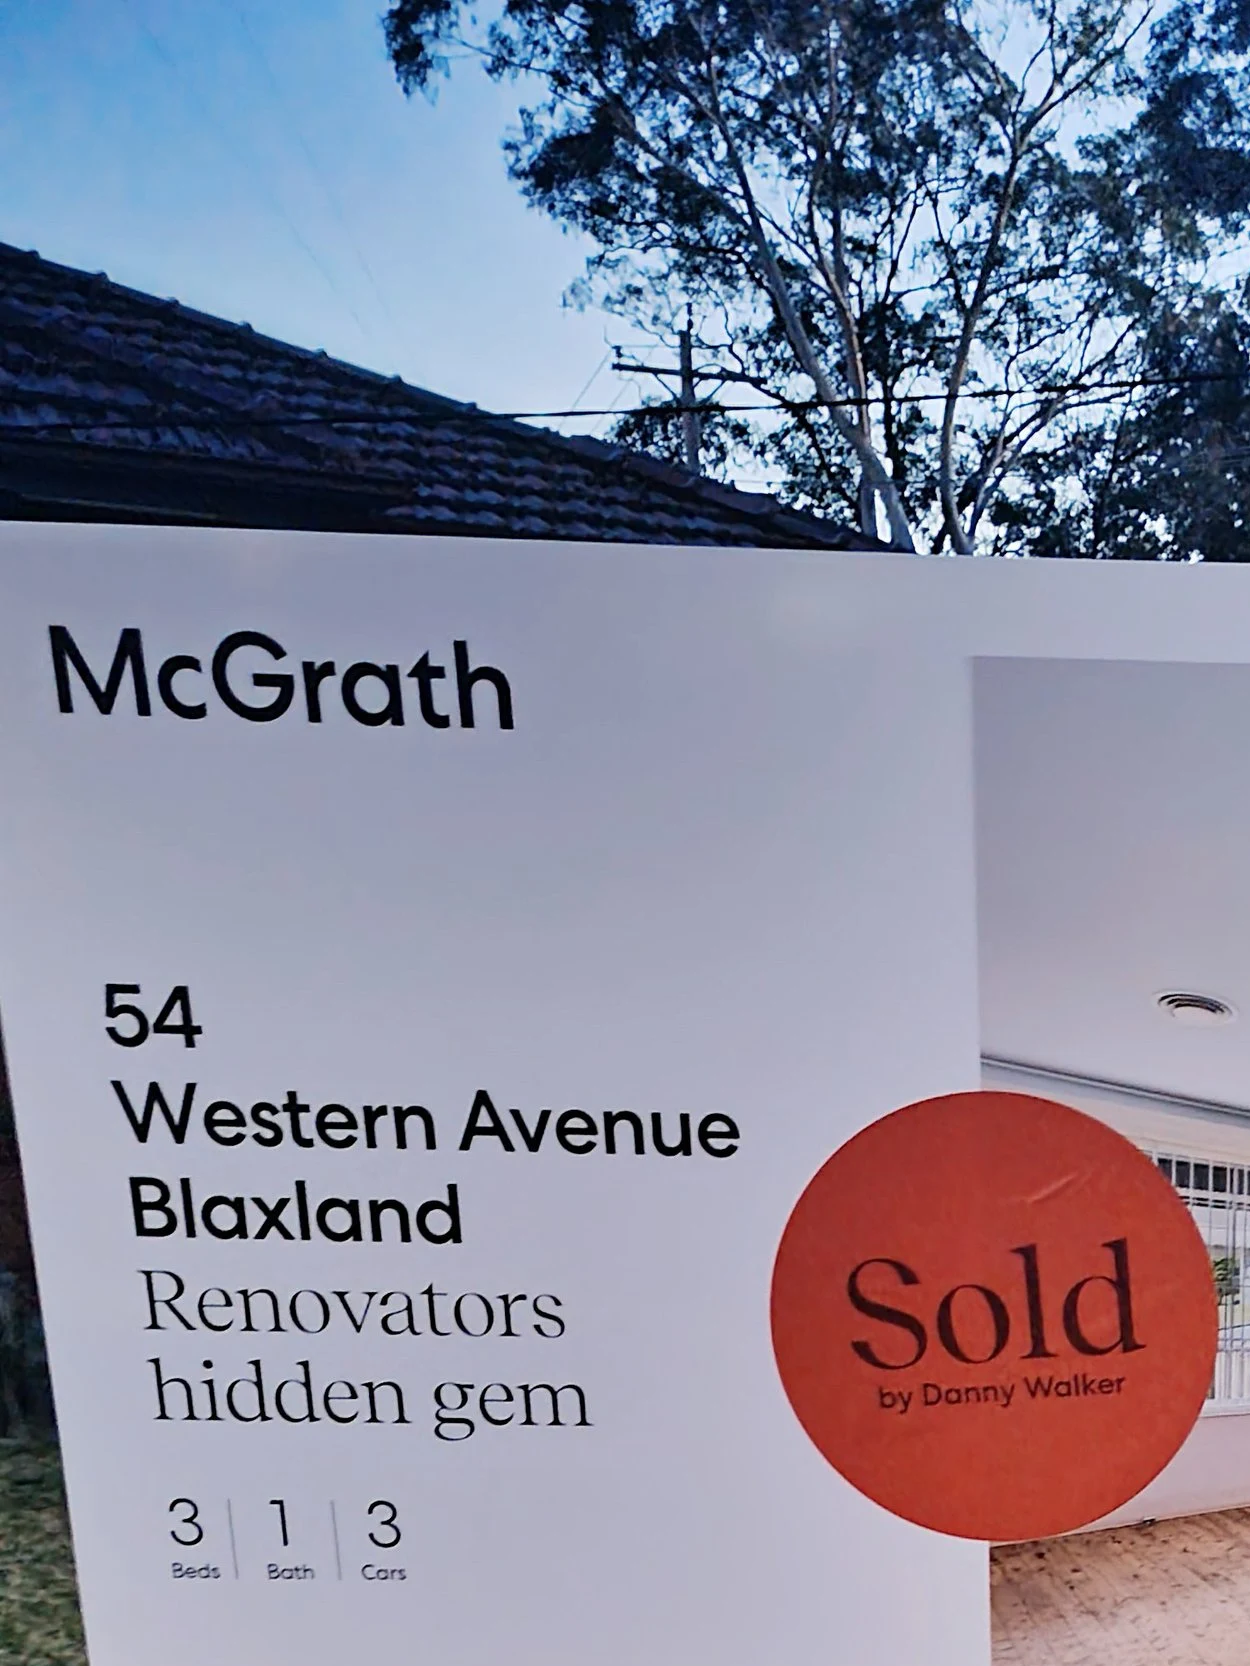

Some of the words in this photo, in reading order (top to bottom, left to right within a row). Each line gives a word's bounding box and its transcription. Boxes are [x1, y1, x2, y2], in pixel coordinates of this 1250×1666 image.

[48, 625, 515, 730] McGrath
[105, 983, 203, 1049] 54
[110, 1080, 437, 1151] Western
[458, 1089, 741, 1159] Avenue
[128, 1176, 463, 1245] Blaxland
[137, 1270, 566, 1338] Renovators
[846, 1238, 1146, 1370] Sold
[147, 1357, 411, 1424] hidden
[433, 1382, 594, 1442] gem
[878, 1386, 913, 1415] by
[922, 1382, 1015, 1408] Danny
[1023, 1373, 1125, 1399] Walker
[168, 1497, 204, 1546] 3
[269, 1499, 289, 1547] 1
[367, 1500, 402, 1549] 3
[172, 1562, 221, 1579] Beds
[267, 1563, 313, 1580] Bath
[361, 1564, 407, 1581] Cars
